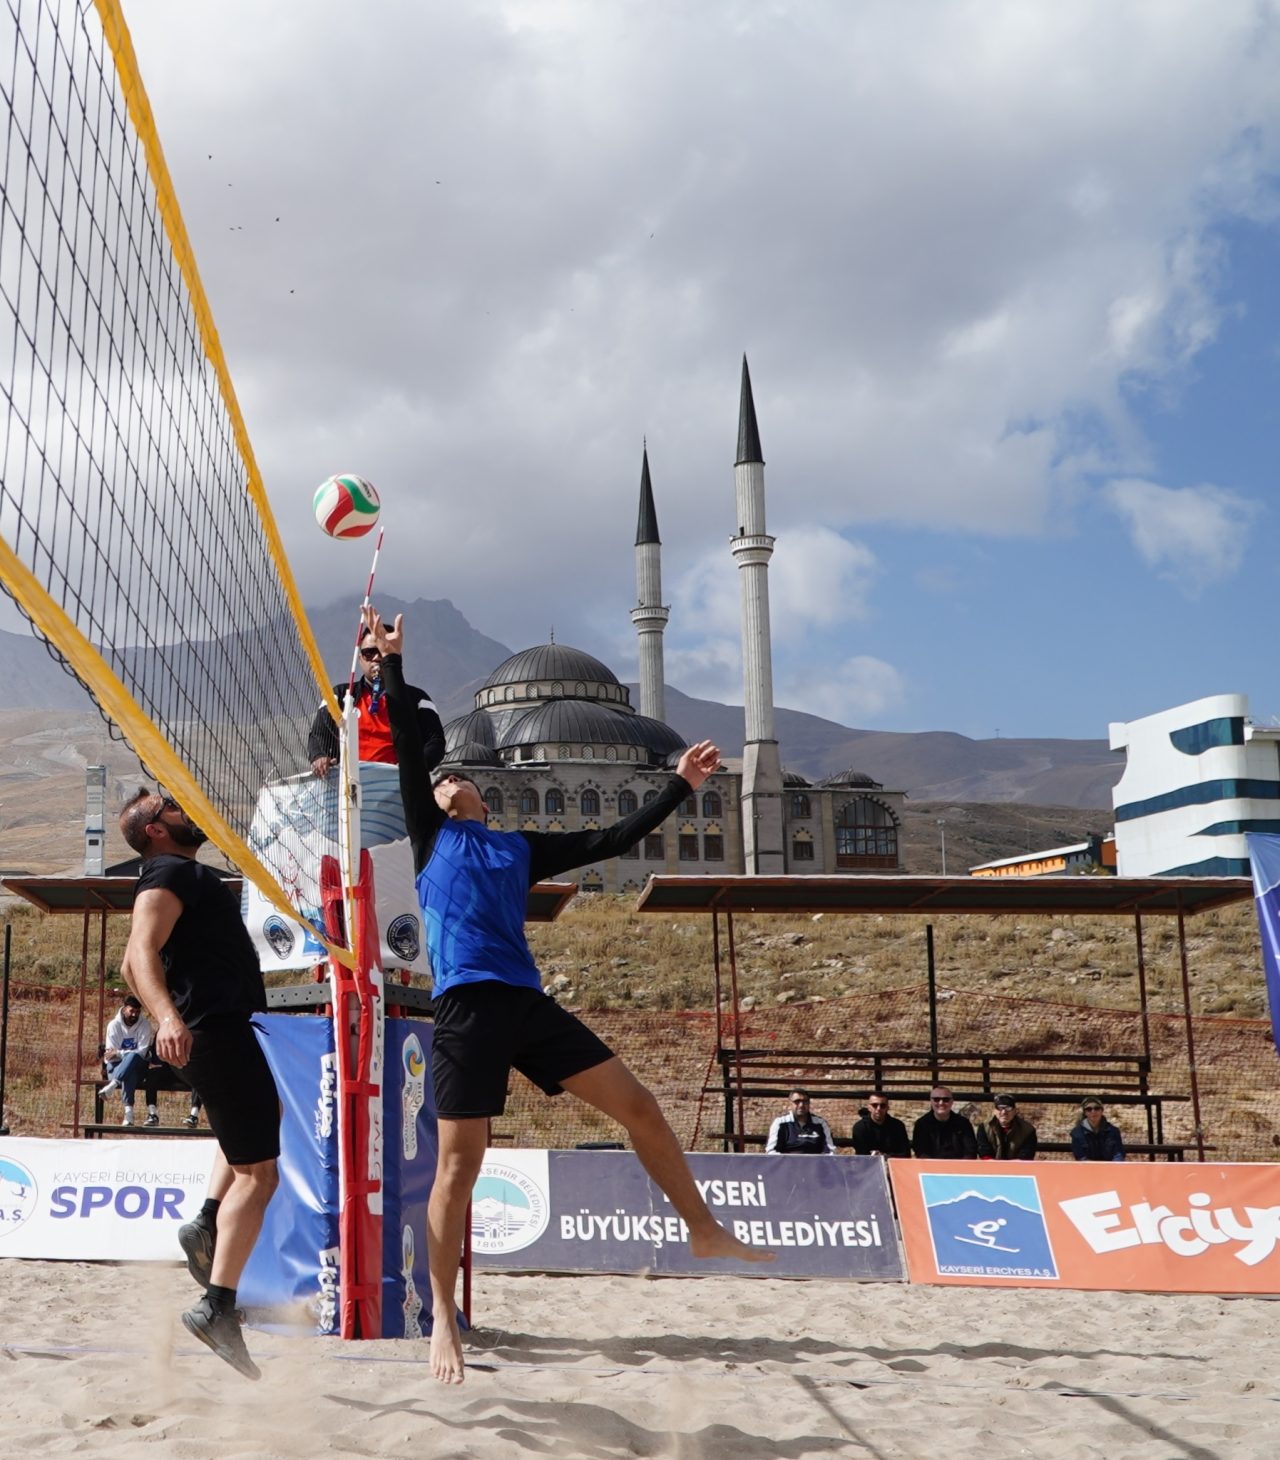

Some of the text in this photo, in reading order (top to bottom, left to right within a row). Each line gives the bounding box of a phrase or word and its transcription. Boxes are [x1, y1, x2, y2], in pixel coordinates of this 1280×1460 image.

[372, 1111, 382, 1156] TVF
[50, 1186, 185, 1220] SPOR
[663, 1174, 767, 1207] YSERİ
[733, 1214, 882, 1247] BELEDİYESİ
[1058, 1190, 1280, 1266] Erciy
[940, 1265, 984, 1274] KAYSERİ
[987, 1266, 1032, 1276] ERCİYES
